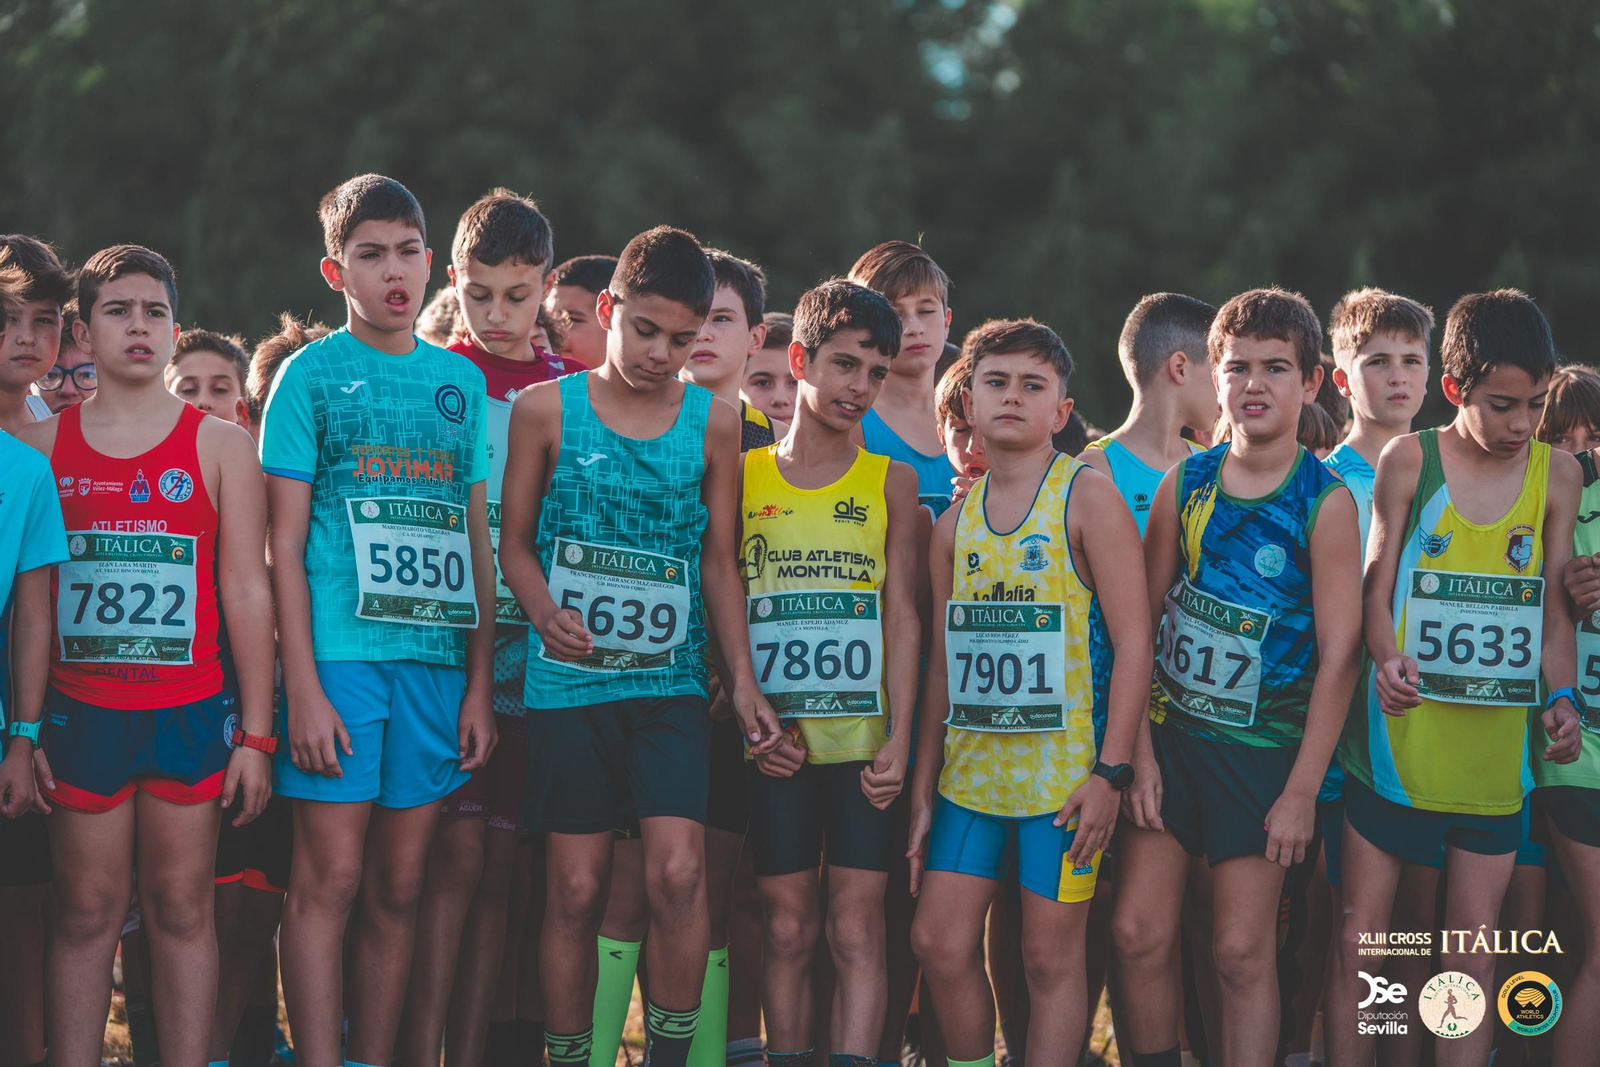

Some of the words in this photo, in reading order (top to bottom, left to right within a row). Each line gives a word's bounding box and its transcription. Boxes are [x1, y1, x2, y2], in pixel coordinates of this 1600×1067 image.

[352, 456, 454, 484] JOVIMAR
[358, 472, 416, 484] Equipamos
[430, 477, 438, 485] tu
[389, 500, 444, 521] ITÁLICA
[91, 520, 168, 532] ATLETISMO
[95, 536, 162, 554] ITÁLICA
[592, 551, 656, 572] ITÁLICA
[767, 550, 802, 562] CLUB
[370, 542, 465, 592] 5850
[777, 566, 872, 583] MONTILLA
[570, 570, 602, 580] FRANCISCO
[603, 576, 636, 586] CARRASCO
[1449, 577, 1514, 596] ITÁLICA
[70, 582, 186, 626] 7822
[781, 595, 845, 612] ITÁLICA
[1182, 589, 1231, 624] ITÁLICA
[561, 588, 677, 644] 5639
[971, 606, 1026, 623] ITÁLICA
[1417, 620, 1532, 668] 5633
[756, 640, 872, 683] 7860
[1168, 629, 1251, 690] 617
[96, 668, 160, 680] DENTAL
[956, 652, 1053, 694] 7901
[488, 820, 516, 831] AGUERE
